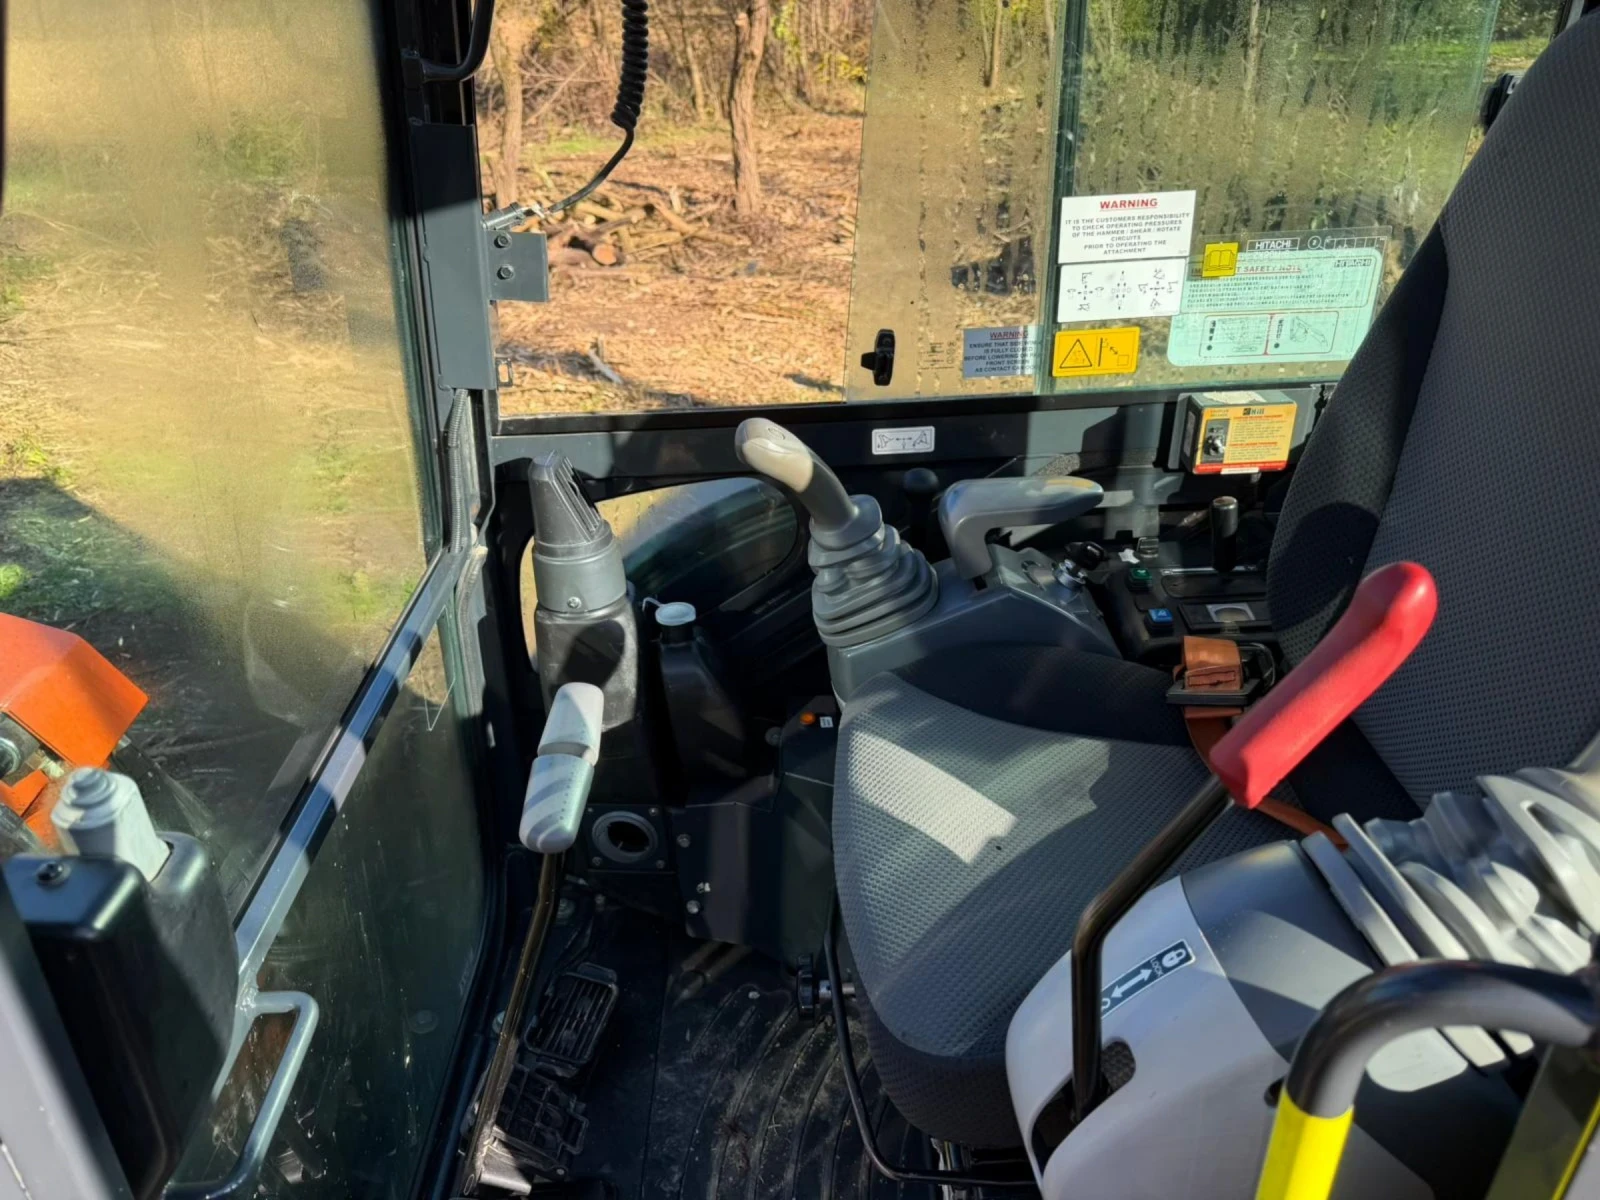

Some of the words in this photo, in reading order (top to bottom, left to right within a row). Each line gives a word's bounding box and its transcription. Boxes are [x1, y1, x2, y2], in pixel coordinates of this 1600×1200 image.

[1100, 198, 1158, 209] WARNING
[1137, 212, 1190, 220] RESPONSIBILITY
[1255, 240, 1293, 250] HITACHI
[990, 331, 1028, 339] WARNING
[1149, 956, 1165, 978] LOCK
